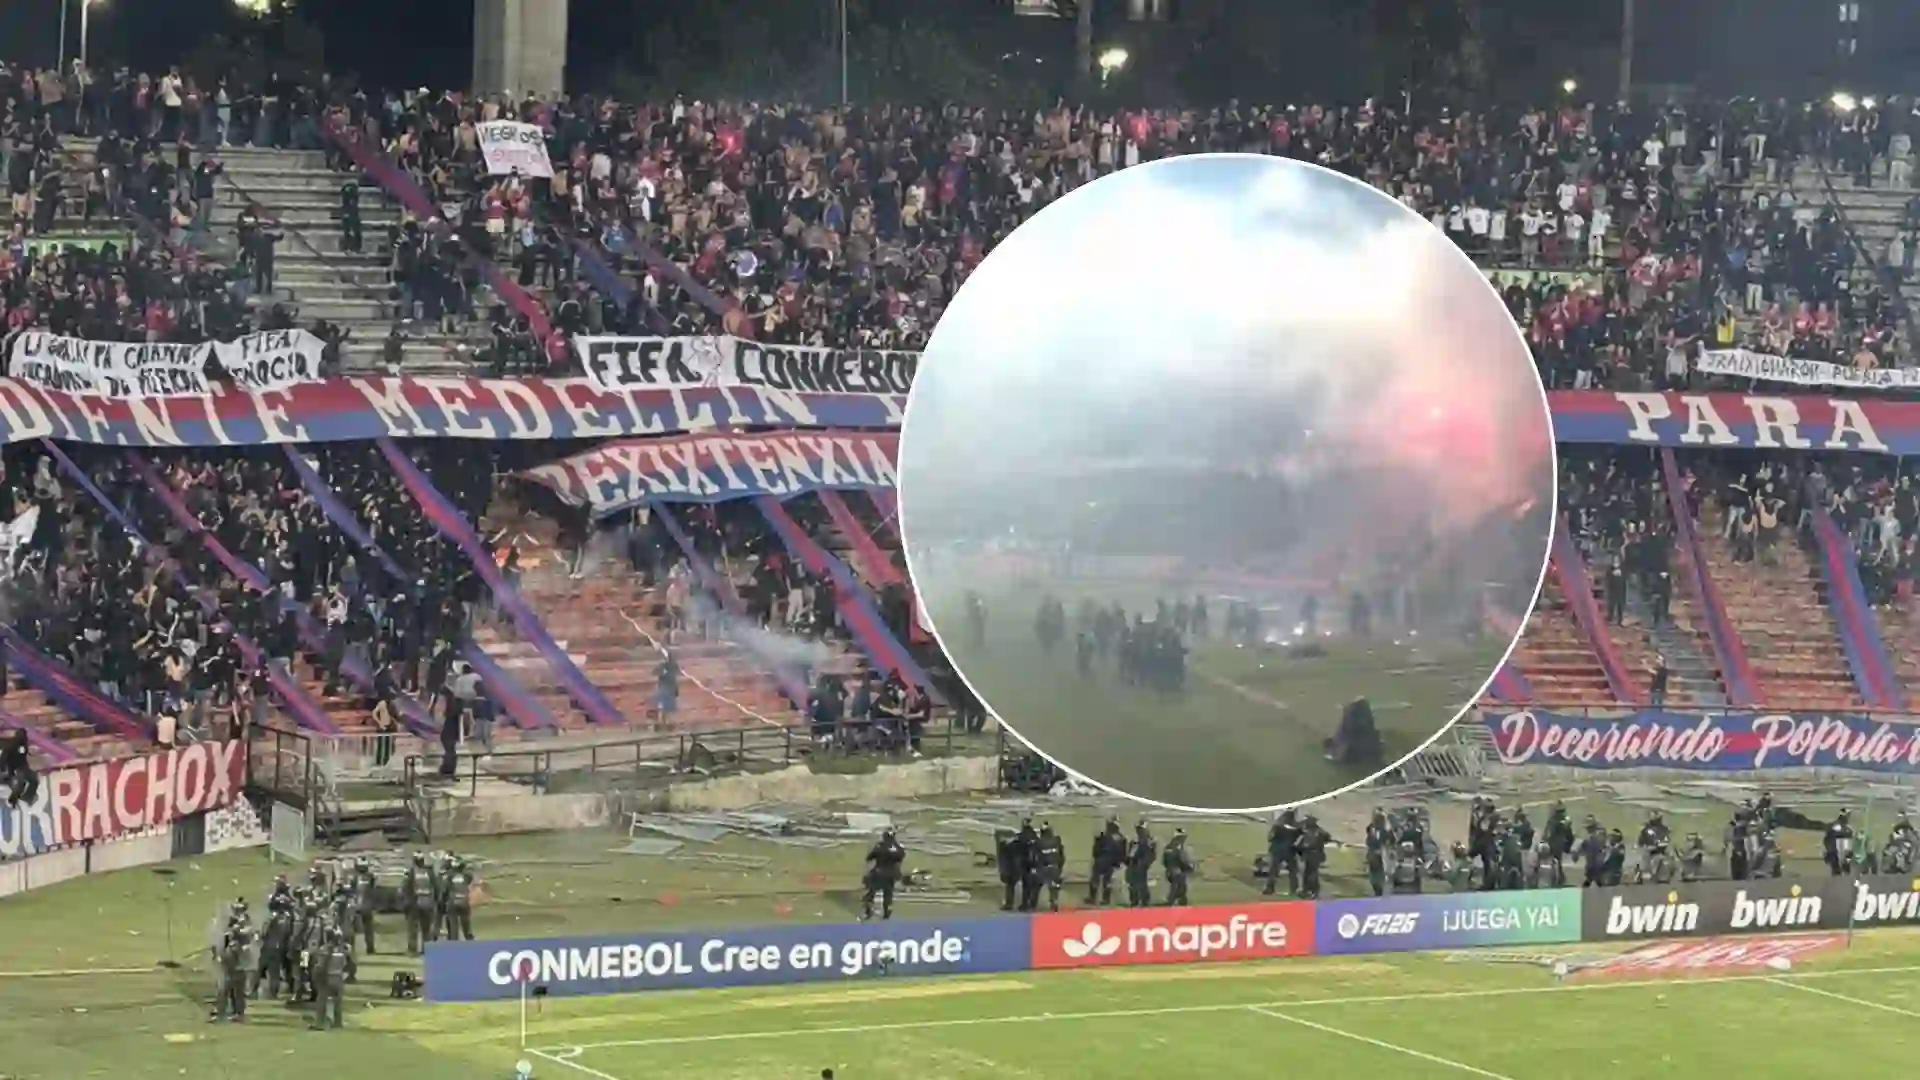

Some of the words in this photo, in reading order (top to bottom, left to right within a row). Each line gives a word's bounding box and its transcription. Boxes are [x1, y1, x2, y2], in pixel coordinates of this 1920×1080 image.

[589, 341, 702, 386] FIFA
[1615, 391, 1889, 451] PARA
[1501, 711, 1728, 764] Decorando
[1526, 904, 1559, 929] YA!
[1606, 891, 1700, 935] bwin
[1730, 884, 1822, 928] bwin
[1853, 878, 1920, 921] bwi
[488, 942, 693, 985] CONMEBOL
[700, 939, 780, 972] Cree
[788, 937, 828, 969] en
[840, 930, 963, 975] grande
[1128, 918, 1287, 957] mapfre
